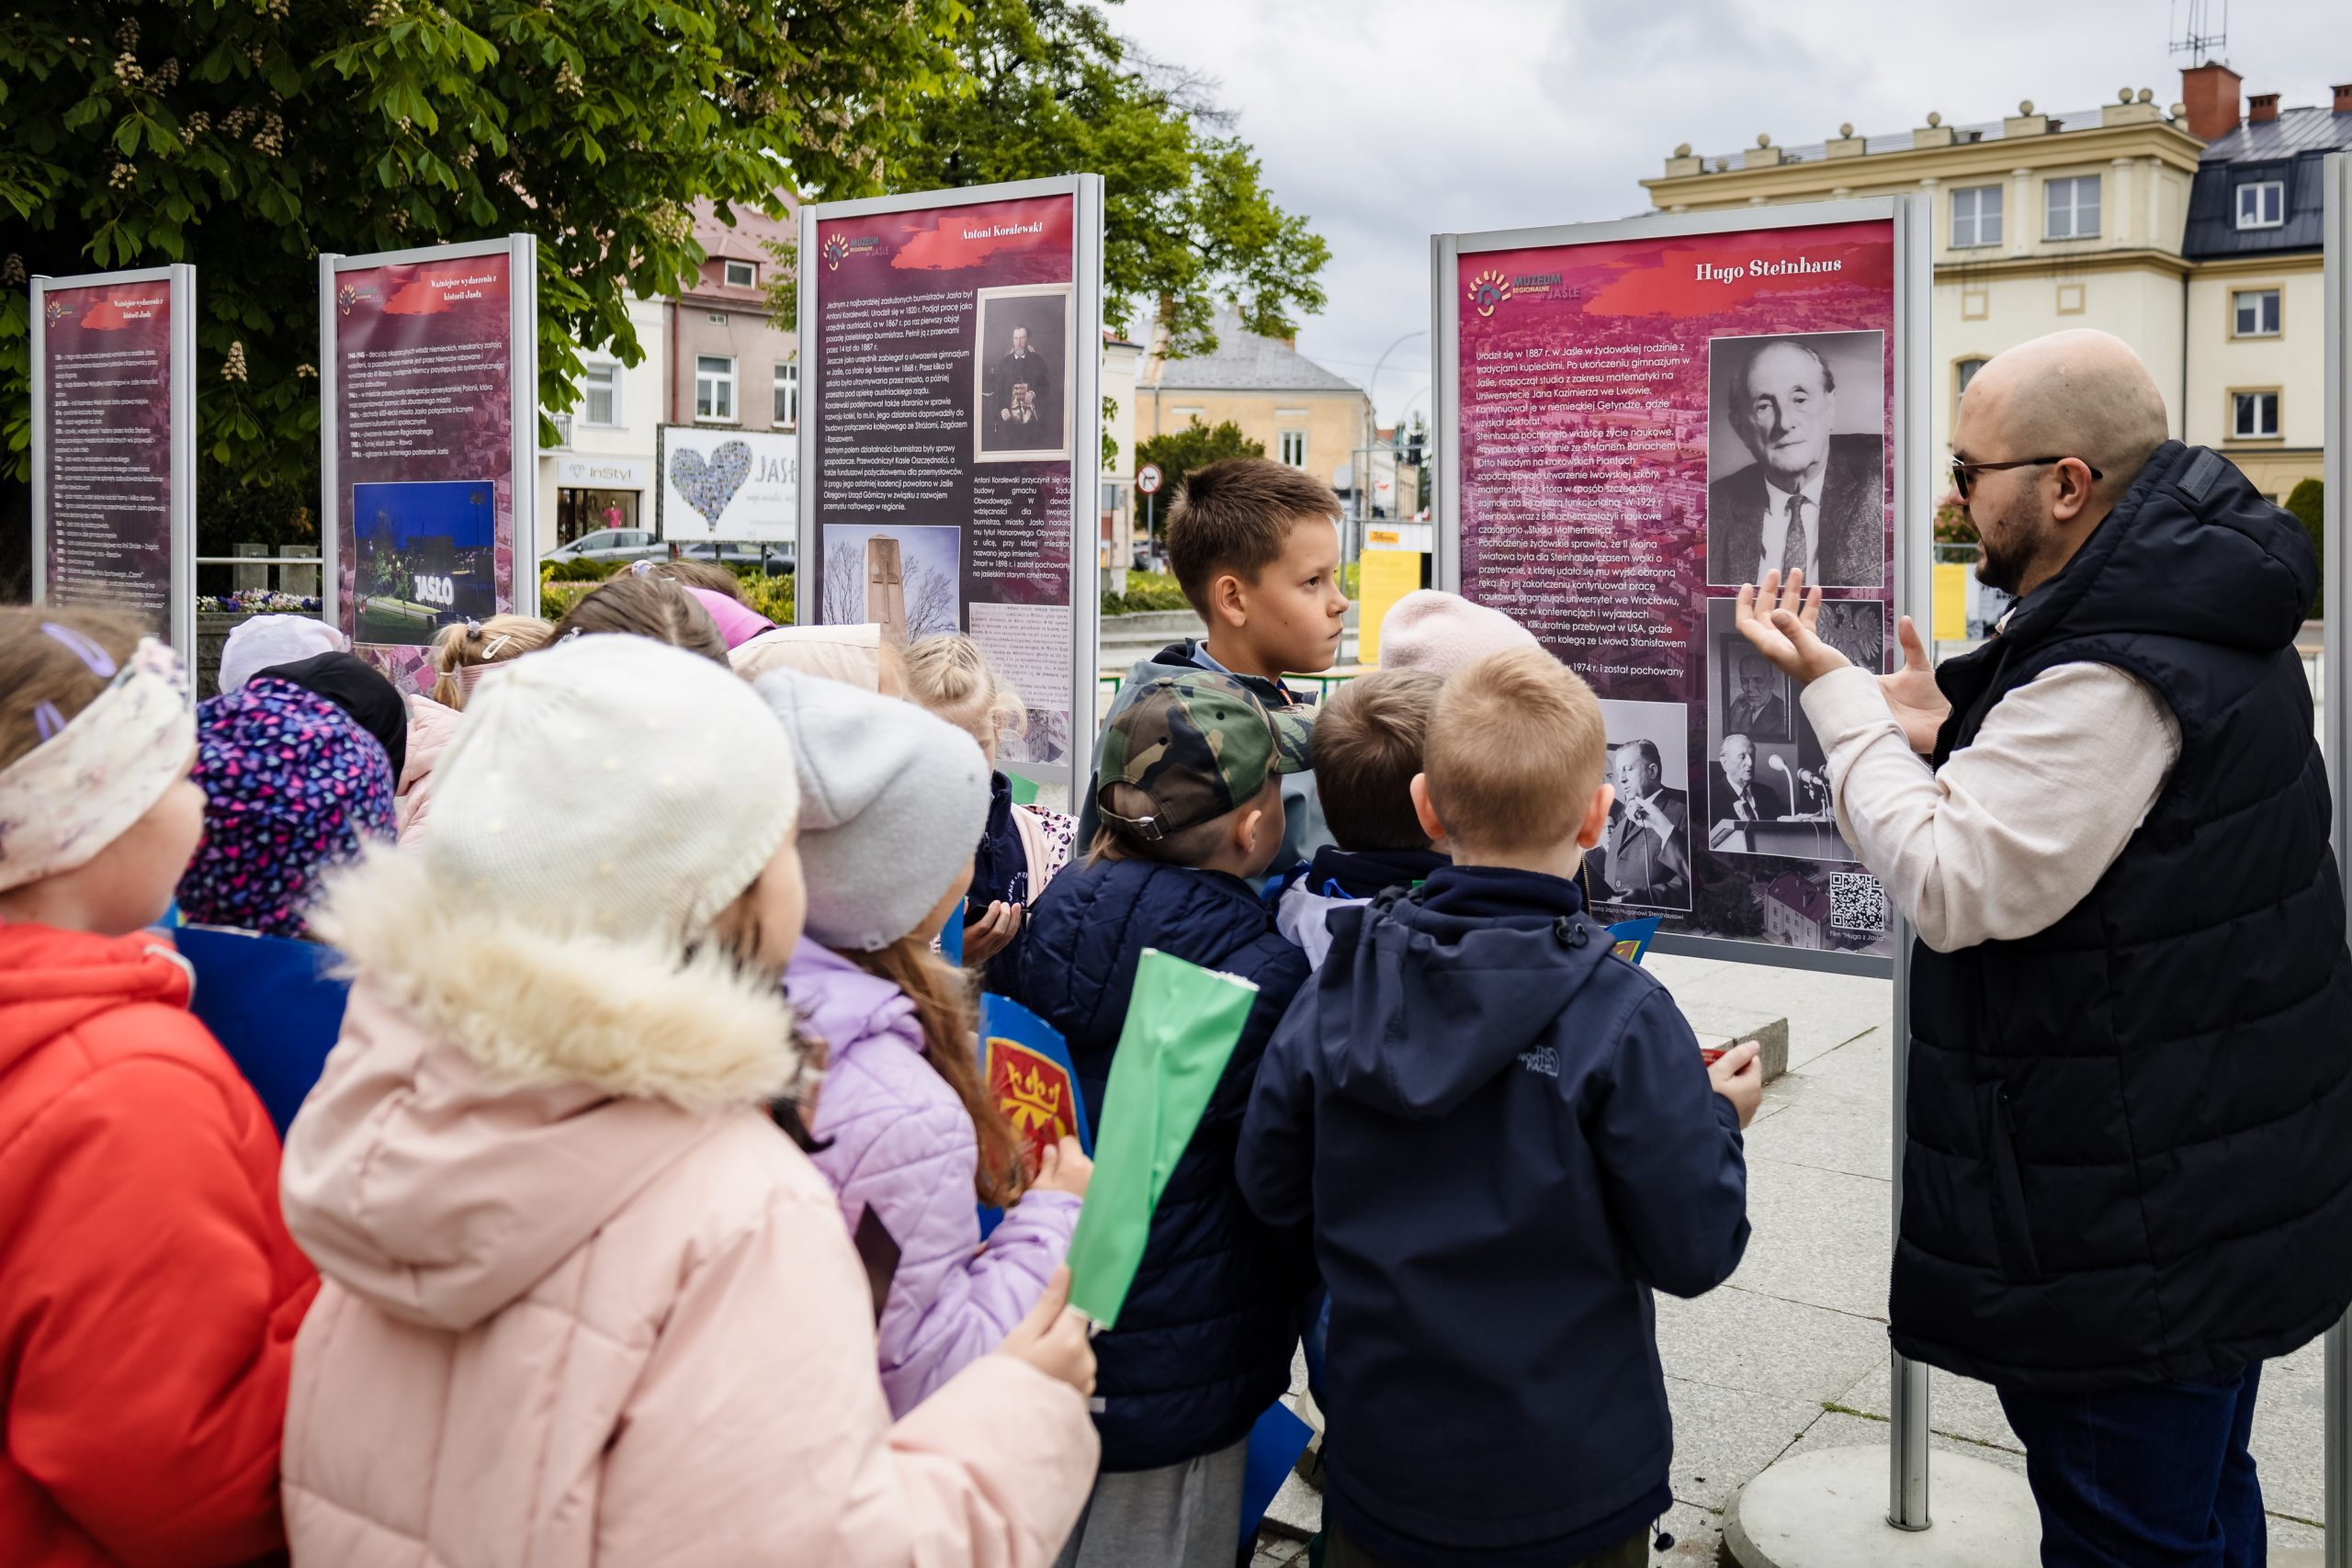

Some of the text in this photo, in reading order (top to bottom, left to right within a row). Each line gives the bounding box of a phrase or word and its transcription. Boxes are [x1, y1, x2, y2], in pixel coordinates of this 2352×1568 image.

[961, 221, 1042, 239] Antoni Koralewski
[1695, 256, 1841, 284] Hugo Steinhaus
[1513, 273, 1561, 287] MUZEUM
[913, 293, 944, 301] burmistrzów
[963, 290, 972, 299] był
[1512, 285, 1550, 294] REGIONALNE
[922, 302, 972, 314] Podjął pracę jako
[921, 317, 942, 326] pierwszy
[944, 314, 959, 324] objął
[930, 326, 959, 337] przerwami
[878, 350, 969, 362] zabiegał gimnazjum
[1476, 351, 1501, 360] Urodził
[1503, 351, 1512, 361] się
[1525, 349, 1542, 358] 1887
[1562, 347, 1582, 356] Jaśle
[1594, 344, 1641, 356] żydowskiej
[1643, 342, 1677, 352] rodzinie
[1476, 363, 1517, 375] tradycjami
[1520, 361, 1564, 373] kupieckimi.
[1567, 361, 1576, 369] Po
[1580, 359, 1628, 368] ukończeniu
[1631, 357, 1679, 369] gimnazjum
[930, 374, 949, 383] później
[1476, 378, 1496, 387] Jaśle,
[1499, 376, 1537, 387] rozpoczął
[1540, 375, 1564, 384] studia
[1572, 374, 1603, 383] zakresu
[1606, 371, 1659, 382] matematyki
[874, 388, 911, 396] austriackiego
[1476, 390, 1529, 401] Uniwersytecie
[1554, 388, 1598, 397] Kazimierza
[1616, 386, 1651, 395] Lwowie.
[930, 397, 950, 407] sprawie
[876, 409, 954, 420] jego doprowadziły
[873, 423, 905, 431] kolejowego
[923, 445, 934, 453] były
[911, 456, 949, 465] Oszczędności,
[755, 456, 796, 484] JASŁ
[918, 468, 963, 477] przemysłowców.
[903, 480, 931, 488] powołano
[920, 491, 947, 500] rozwojem
[882, 503, 906, 511] regionie.
[997, 528, 1033, 537] Honorowego
[1478, 525, 1522, 535] czasopismo
[1530, 539, 1568, 549] żydowskie
[1571, 539, 1608, 549] sprawiło,
[1630, 539, 1656, 550] wojna
[1478, 552, 1514, 560] światowa
[1516, 552, 1534, 562] była
[1550, 553, 1594, 561] Steinhausa
[1632, 554, 1653, 562] walki
[1533, 566, 1555, 576] której
[1583, 567, 1593, 577] się
[1612, 567, 1635, 577] wyjść
[1638, 567, 1675, 578] obronną
[414, 575, 454, 605] JASŁO
[1512, 579, 1520, 589] jej
[1522, 579, 1569, 588] zakończeniu
[1572, 580, 1627, 591] kontynuował
[1629, 584, 1655, 592] pracę
[1479, 592, 1517, 603] naukową,
[1519, 593, 1564, 604] organizując
[1566, 594, 1612, 605] uniwersytet
[1630, 596, 1678, 606] Wrocławiu,
[1538, 607, 1648, 619] konferencjach wyjazdach
[1527, 620, 1570, 629] Kilkukrotnie
[1572, 622, 1615, 633] przebywał
[1627, 624, 1645, 634] USA,
[1648, 625, 1672, 635] gdzie
[1558, 635, 1584, 646] kolegą
[1598, 636, 1628, 645] Lwowa
[1630, 637, 1686, 648] Stanisławem
[1573, 663, 1590, 671] 1974
[1604, 665, 1628, 673] został
[1631, 666, 1683, 678] pochowany
